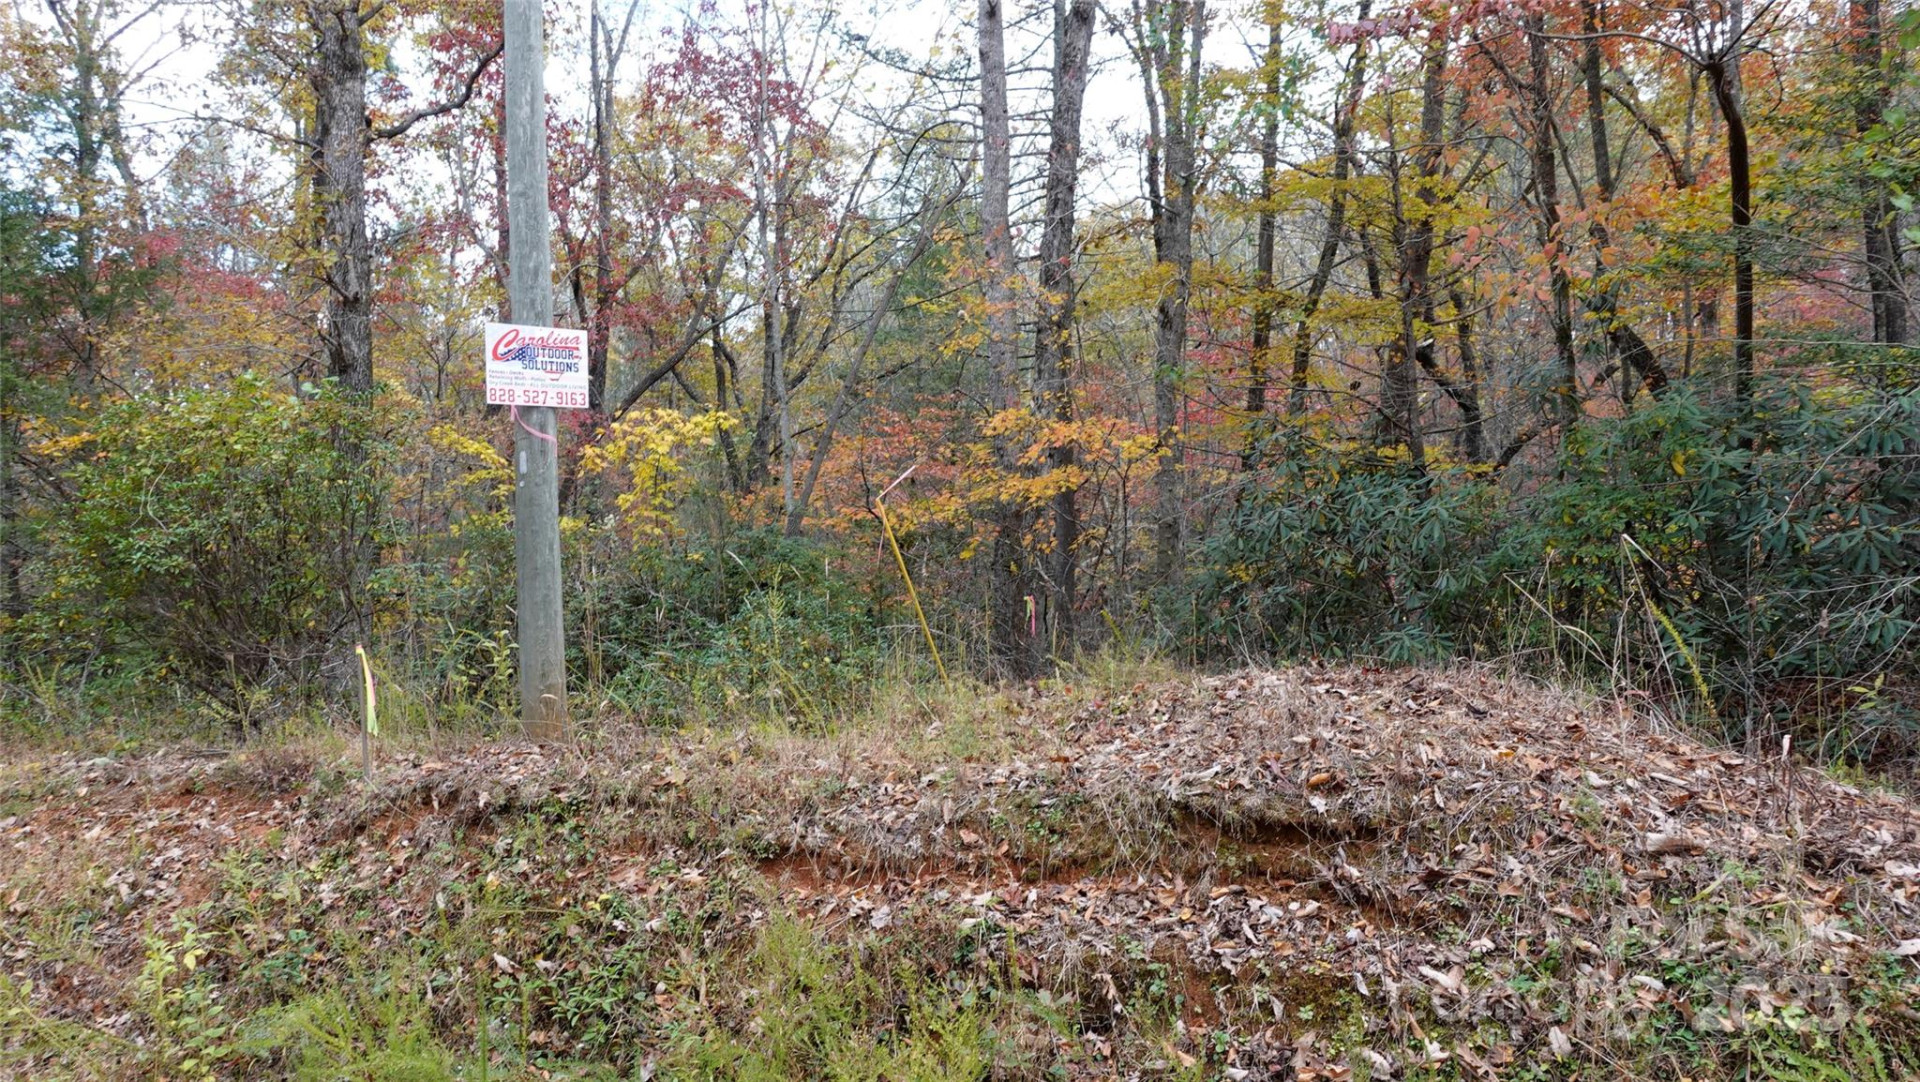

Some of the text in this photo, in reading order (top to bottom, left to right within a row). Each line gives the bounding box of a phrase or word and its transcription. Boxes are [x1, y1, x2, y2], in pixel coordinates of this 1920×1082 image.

[492, 329, 581, 361] Carolina
[526, 346, 574, 360] OUTDOOR
[522, 359, 580, 373] SOLUTIONS
[489, 388, 586, 406] 828-527-9163
